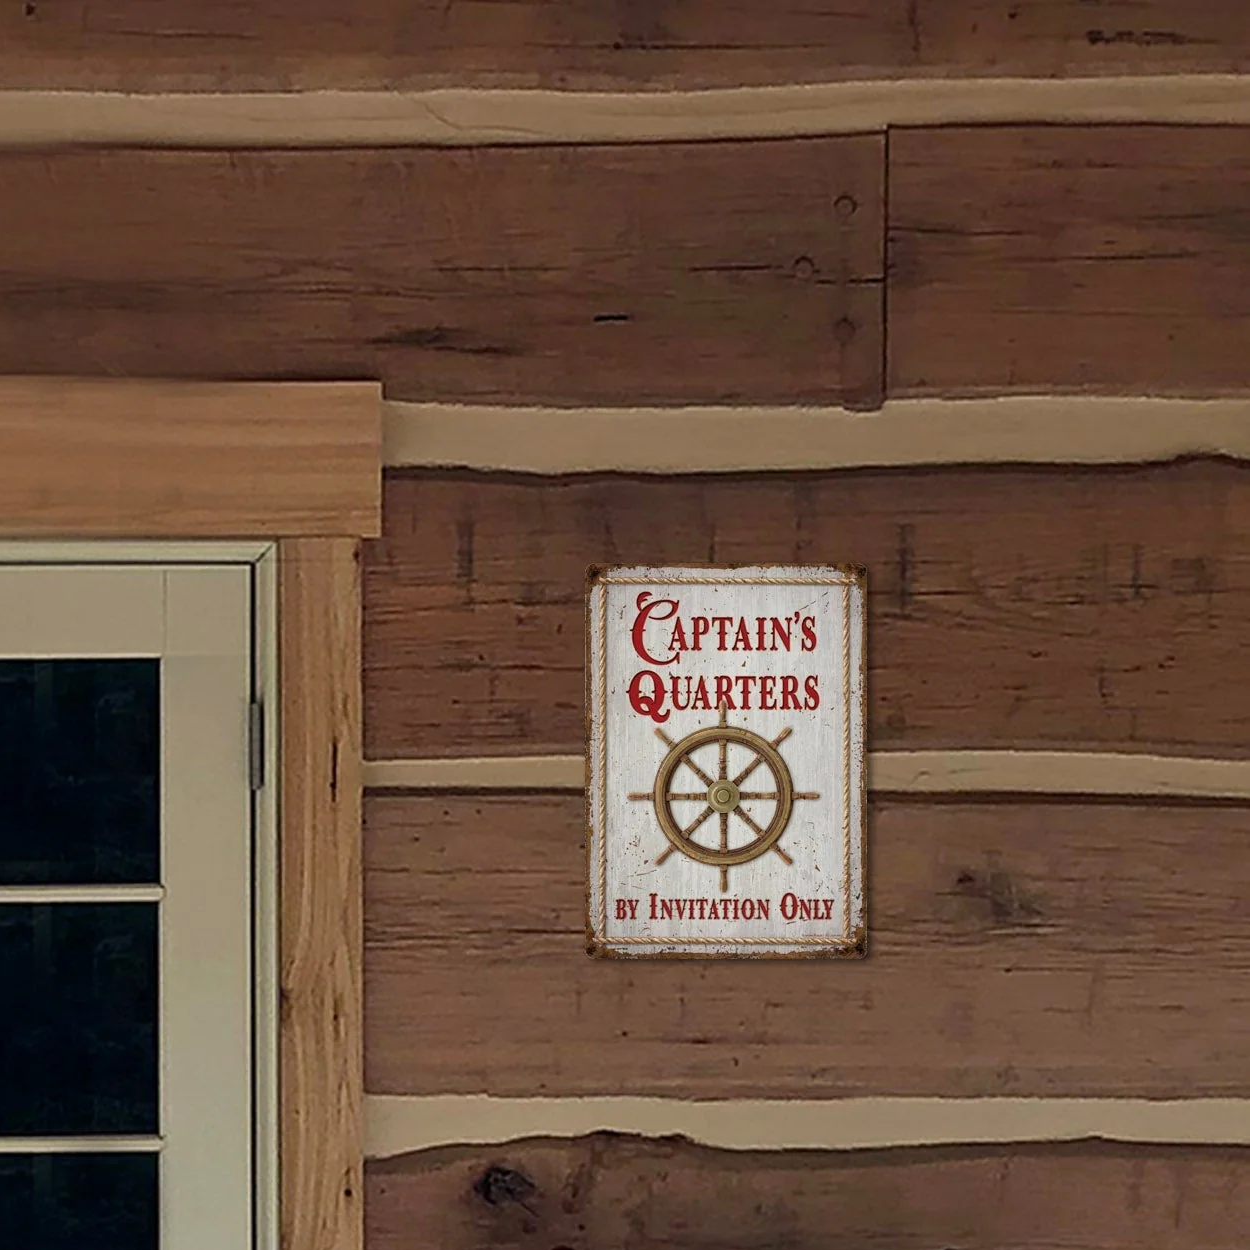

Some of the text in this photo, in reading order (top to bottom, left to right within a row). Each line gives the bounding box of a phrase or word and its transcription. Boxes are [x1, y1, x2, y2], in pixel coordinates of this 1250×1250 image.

[630, 591, 817, 665] CAPTAIN'S
[626, 670, 820, 723] QUARTERS
[615, 892, 834, 921] BY INVITATION ONLY
